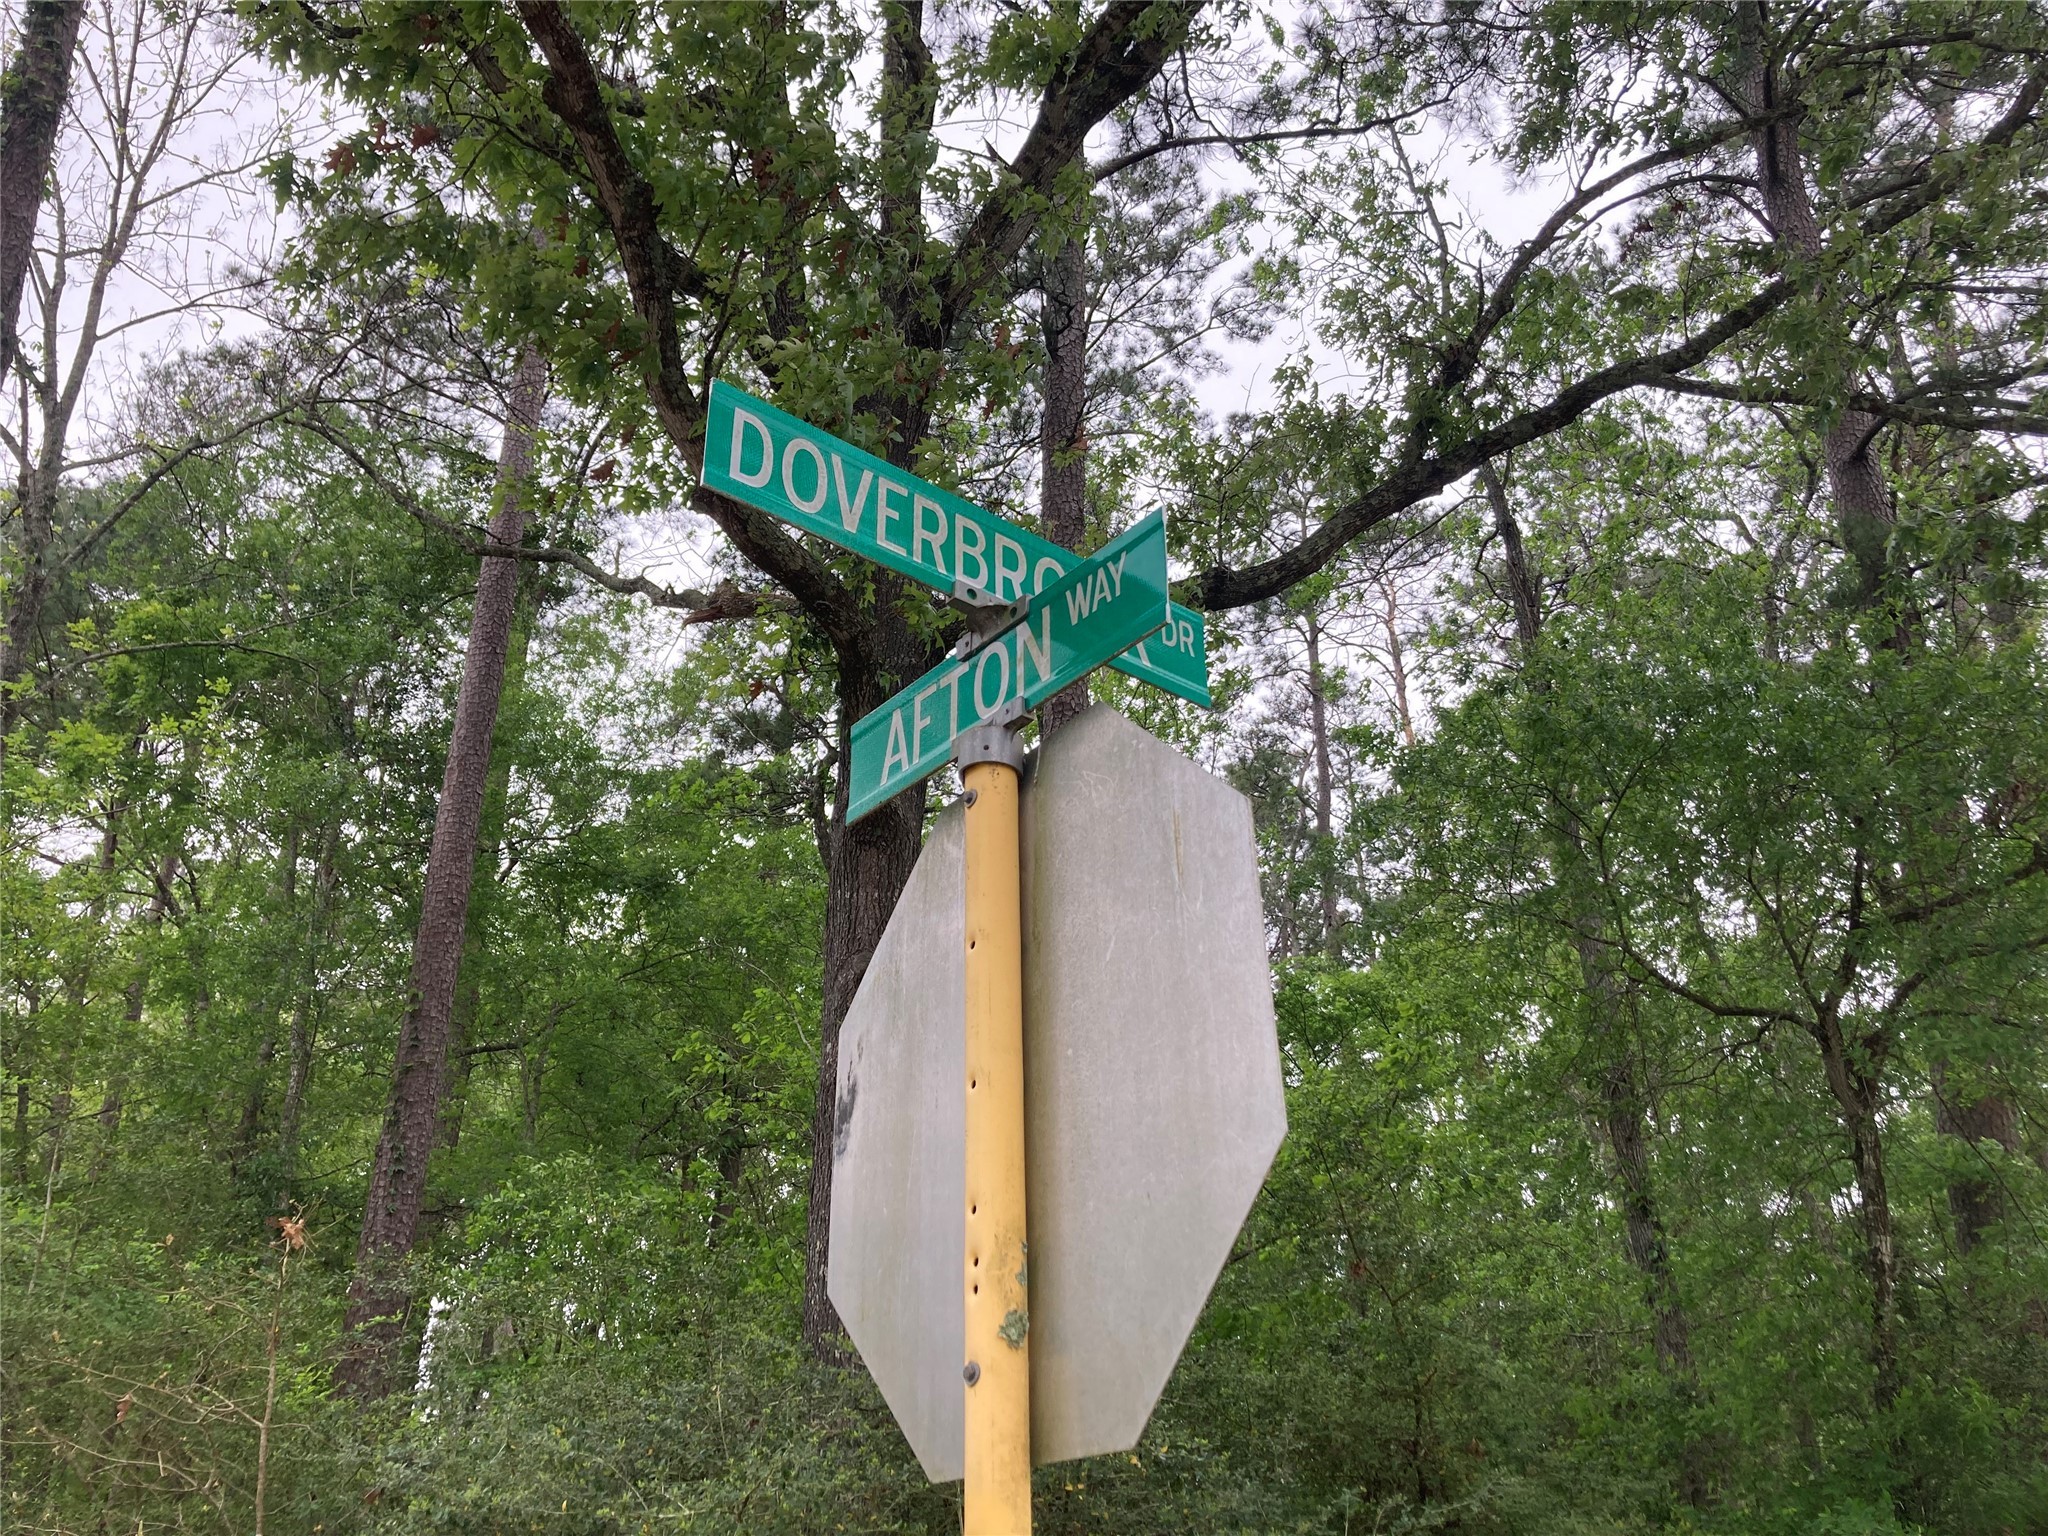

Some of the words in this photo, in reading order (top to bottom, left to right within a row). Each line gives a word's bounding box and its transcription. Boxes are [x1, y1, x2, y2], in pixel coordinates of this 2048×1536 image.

[728, 406, 1151, 667] DOVERBR
[1161, 618, 1196, 658] DR
[879, 604, 1051, 786] AFTON
[1065, 550, 1128, 627] WAY
